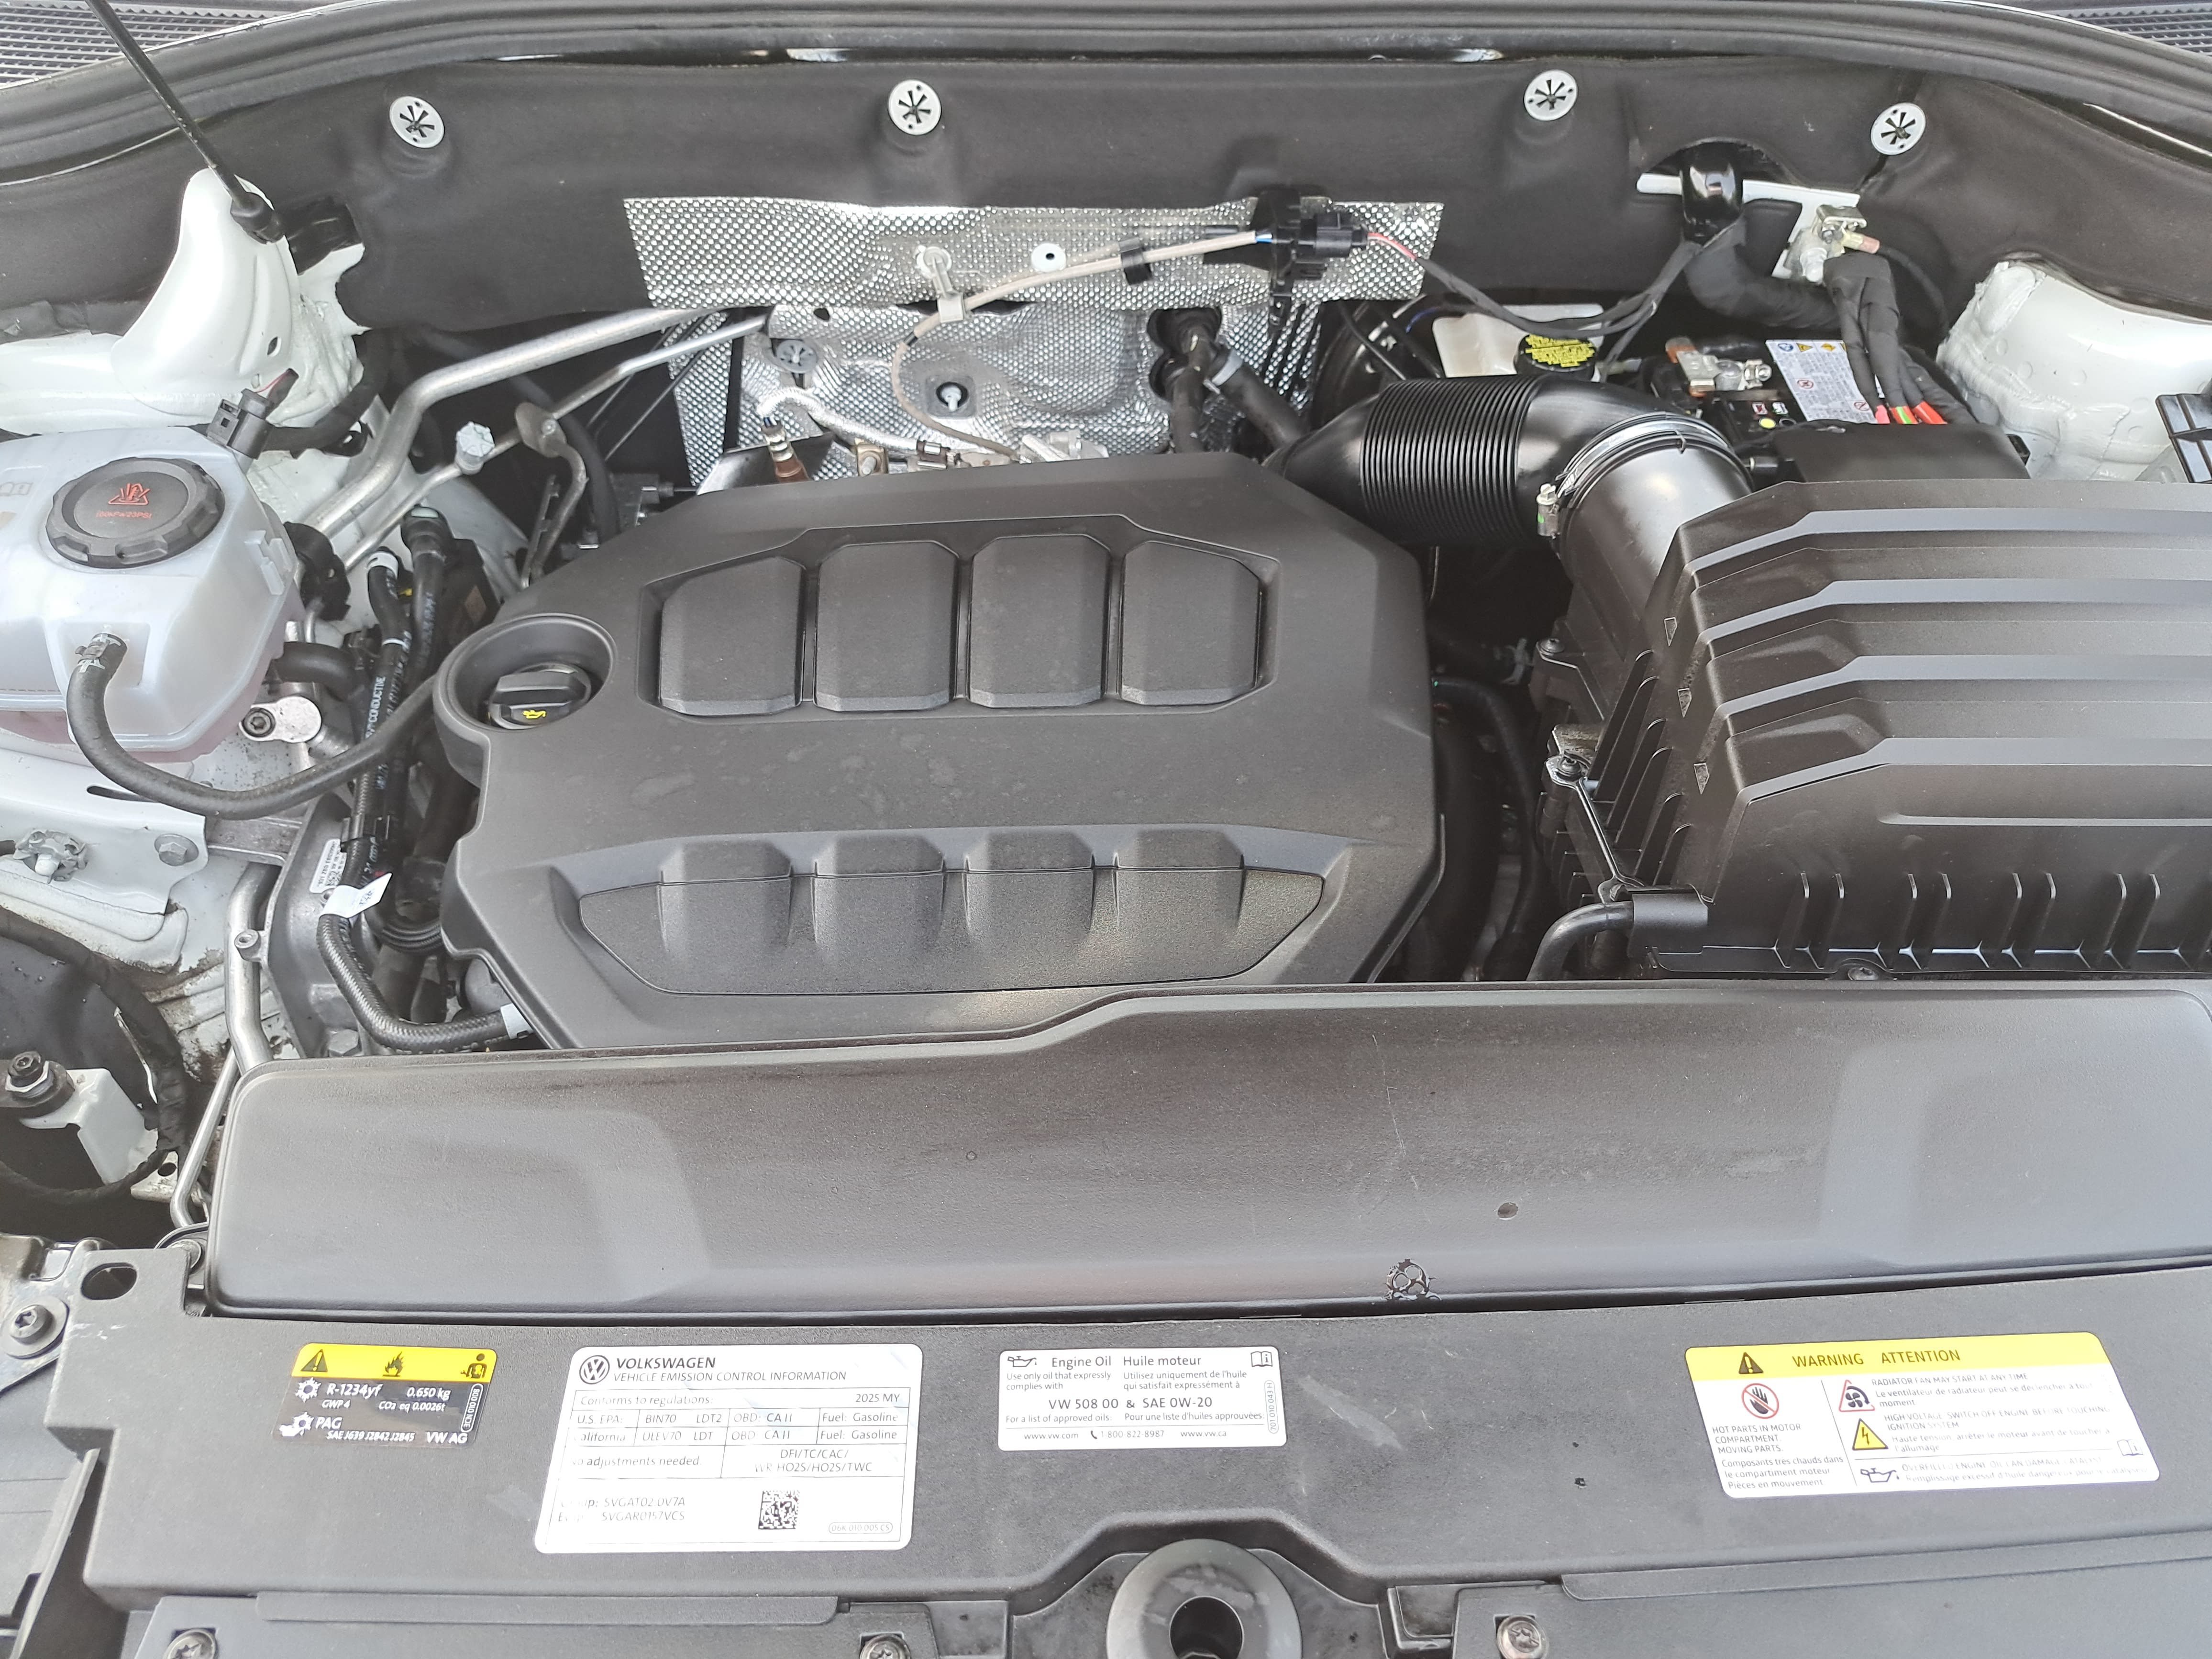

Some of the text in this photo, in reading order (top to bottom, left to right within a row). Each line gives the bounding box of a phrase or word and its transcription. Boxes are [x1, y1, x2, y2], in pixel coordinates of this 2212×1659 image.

[368, 676, 386, 722] CONDUCTIVE
[617, 1357, 716, 1369] VOLKSWAGEN
[1052, 1356, 1201, 1370] Engine Oil Huile moteur
[1792, 1349, 1961, 1367] WARNING ATTENTION
[614, 1371, 846, 1382] VEHICLE EMISSION CONTROL INFORMATION
[1024, 1371, 1041, 1382] only
[1043, 1371, 1053, 1380] oil
[1073, 1371, 1111, 1381] expressly
[1156, 1371, 1208, 1381] uniquement
[1222, 1370, 1247, 1378] l'huile
[1871, 1377, 1913, 1386] RADIATOR
[1952, 1375, 1977, 1383] START
[327, 1382, 451, 1401] R-1234yf 0.650 kg
[1006, 1383, 1042, 1392] complies
[1124, 1382, 1137, 1392] qui
[1174, 1381, 1233, 1391] expressément
[1887, 1388, 1932, 1397] ventilateur
[1947, 1387, 1985, 1395] radiateur
[1988, 1385, 2007, 1394] peut
[471, 1388, 480, 1402] 008
[581, 1394, 900, 1407] Conforms to regulations: 2025 MY
[321, 1400, 343, 1408] GWP
[343, 1400, 351, 1408] 4
[399, 1403, 410, 1413] eq
[412, 1402, 445, 1412] 0.0026t
[467, 1402, 476, 1414] 010
[1049, 1397, 1213, 1409] VW 508 00 & SAE 0W-20
[600, 1415, 623, 1424] EPA:
[645, 1414, 676, 1423] BIN70
[697, 1414, 722, 1423] LDT2
[734, 1413, 761, 1422] OBD:
[767, 1413, 782, 1422] CA
[822, 1413, 847, 1422] Fuel:
[853, 1412, 898, 1422] Gasoline
[1043, 1414, 1051, 1422] of
[1054, 1414, 1093, 1424] approved
[1215, 1412, 1264, 1422] approuvées:
[1884, 1414, 1905, 1422] HIGH
[1947, 1411, 1979, 1419] SWITCH
[1999, 1409, 2029, 1417] ENGINE
[315, 1417, 343, 1429] PAG
[1712, 1423, 1802, 1434] HOT PARTS IN MOTOR
[1888, 1422, 1925, 1431] IGNITION
[327, 1430, 468, 1444] SAE J639 J2842 J2845 VW AG
[642, 1430, 682, 1441] ULEV70
[694, 1431, 713, 1440] LDT
[765, 1431, 779, 1440] CA
[820, 1431, 845, 1440] Fuel:
[851, 1430, 897, 1439] Gasoline
[1715, 1434, 1781, 1444] COMPARTMENT.
[1998, 1431, 2028, 1439] moteur
[1718, 1444, 1783, 1454] MOVING PARTS.
[586, 1457, 655, 1469] adjustments
[780, 1449, 849, 1459] DFI/TC/CAC/
[1722, 1459, 1773, 1469] Composants
[1775, 1457, 1791, 1466] très
[1792, 1456, 1822, 1465] chauds
[777, 1462, 873, 1472] HO2S/HO2S/TWC
[1735, 1468, 1797, 1479] compartiment
[1800, 1468, 1830, 1476] moteur
[1728, 1481, 1755, 1489] Pièces
[1771, 1479, 1823, 1488] mouvement
